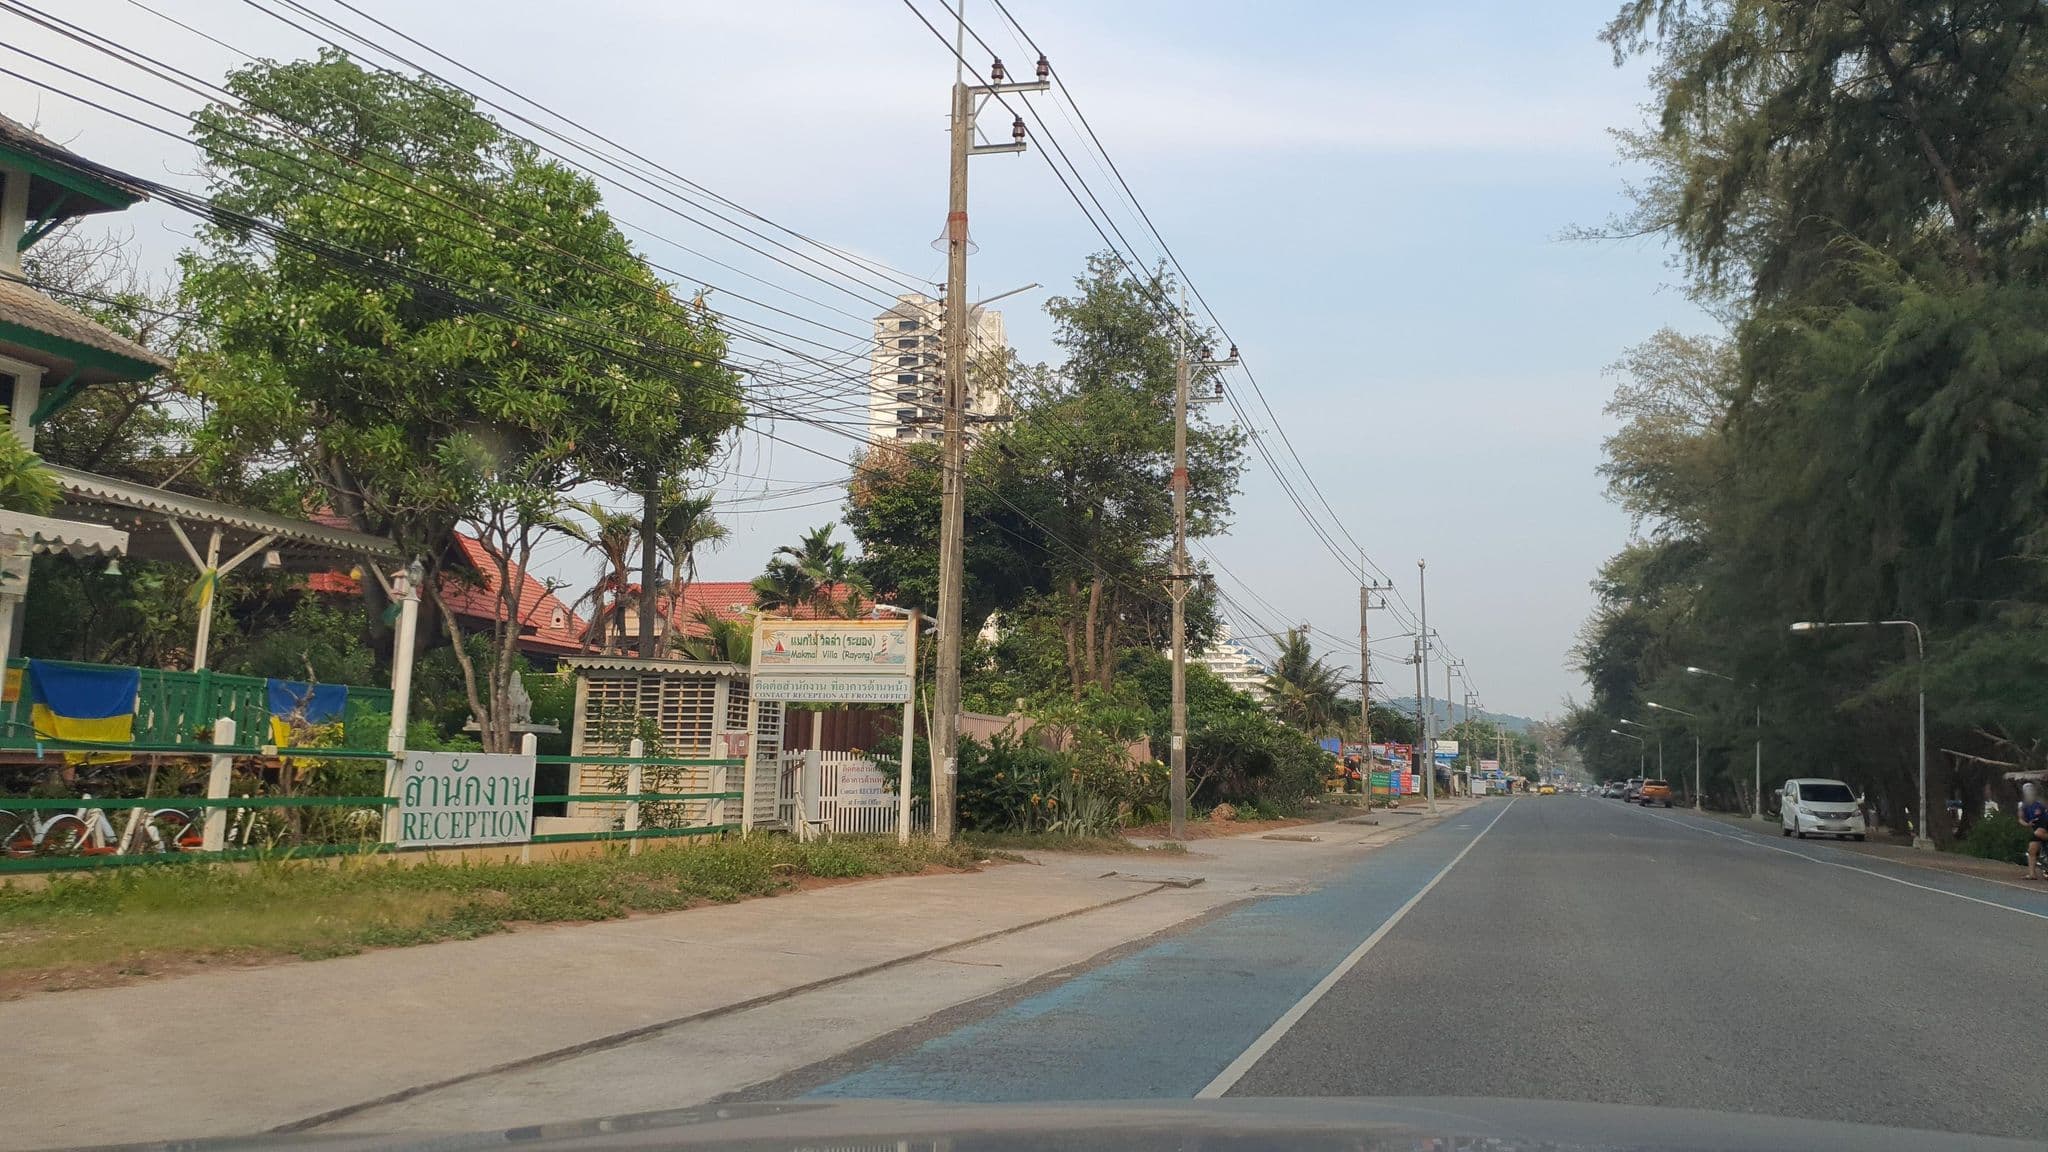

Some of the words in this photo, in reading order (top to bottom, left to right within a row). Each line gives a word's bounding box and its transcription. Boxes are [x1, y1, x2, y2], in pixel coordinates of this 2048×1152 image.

[819, 633, 841, 646] วิลล่า
[842, 634, 876, 649] (ระยอง)
[822, 650, 838, 659] Villa
[842, 650, 874, 662] (Rayong)
[839, 692, 849, 700] AT
[851, 692, 877, 700] FRONT
[405, 758, 530, 807] สำนักงาน
[402, 810, 529, 841] RECEPTION
